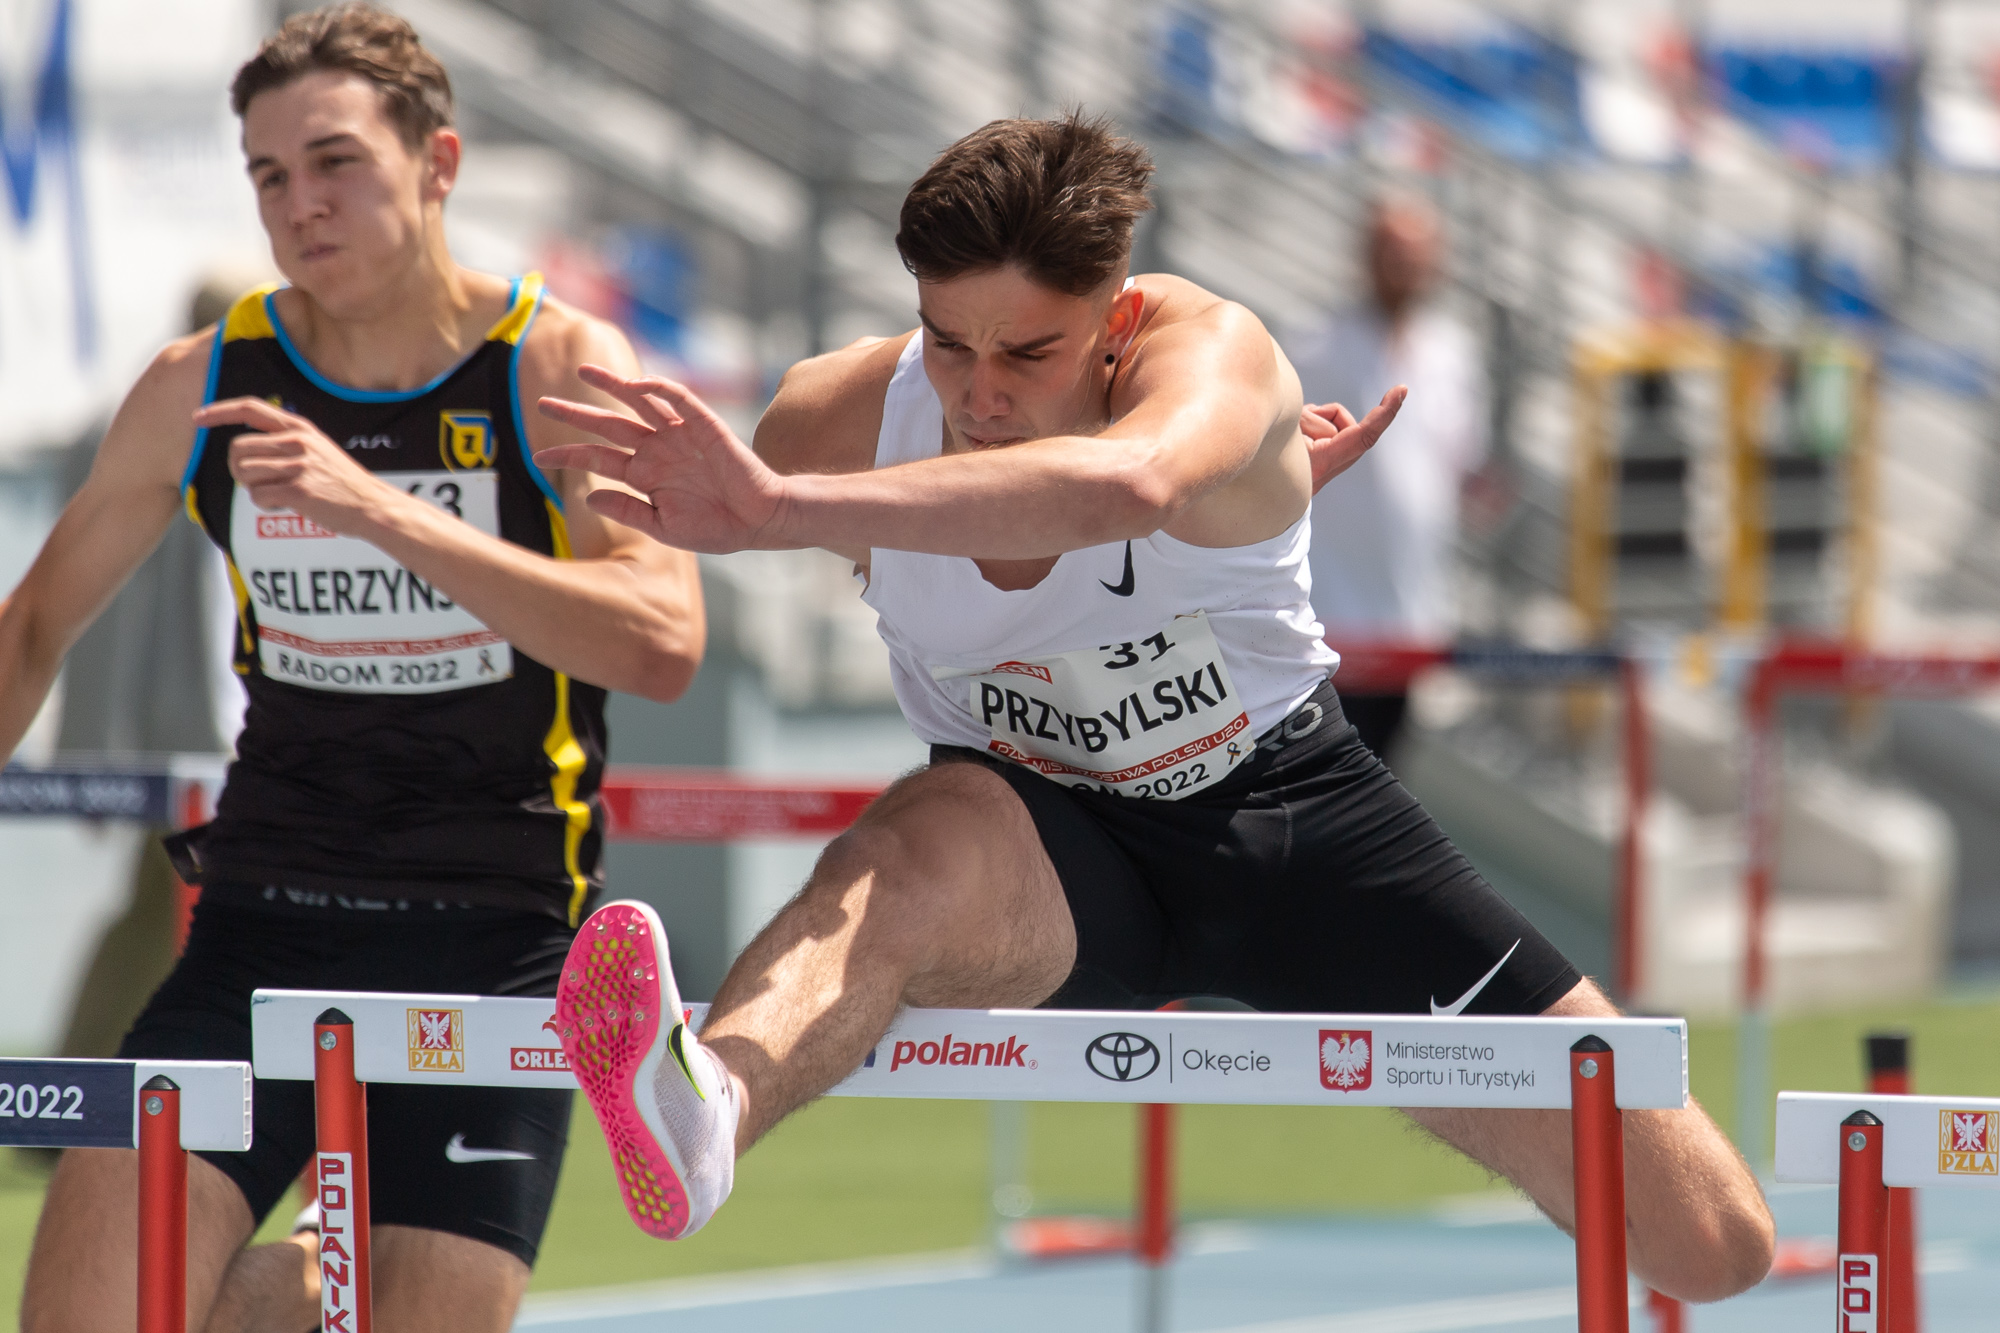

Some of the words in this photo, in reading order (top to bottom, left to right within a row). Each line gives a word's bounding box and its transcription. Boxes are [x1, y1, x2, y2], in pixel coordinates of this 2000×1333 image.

[251, 568, 454, 616] SELERZYN
[1099, 631, 1176, 669] 31
[279, 652, 382, 685] RADOM
[391, 659, 458, 684] 2022
[981, 662, 1228, 753] PRZYBYLSKI
[996, 744, 1028, 761] PZL
[1032, 760, 1149, 782] MISTRZOSTWA
[1151, 739, 1211, 770] POLSKI
[1213, 718, 1244, 744] U20
[1134, 763, 1210, 799] 2022
[411, 1050, 461, 1069] PZLA
[514, 1050, 571, 1069] ORLE
[1182, 1047, 1271, 1076] Okęcie
[1386, 1041, 1494, 1061] Ministerstwo
[1386, 1067, 1443, 1088] Sportu
[1447, 1068, 1453, 1085] i
[1457, 1069, 1535, 1091] Turystyki
[0, 1083, 84, 1120] 2022
[1941, 1153, 1994, 1173] PZLA
[319, 1158, 352, 1333] POLANIK
